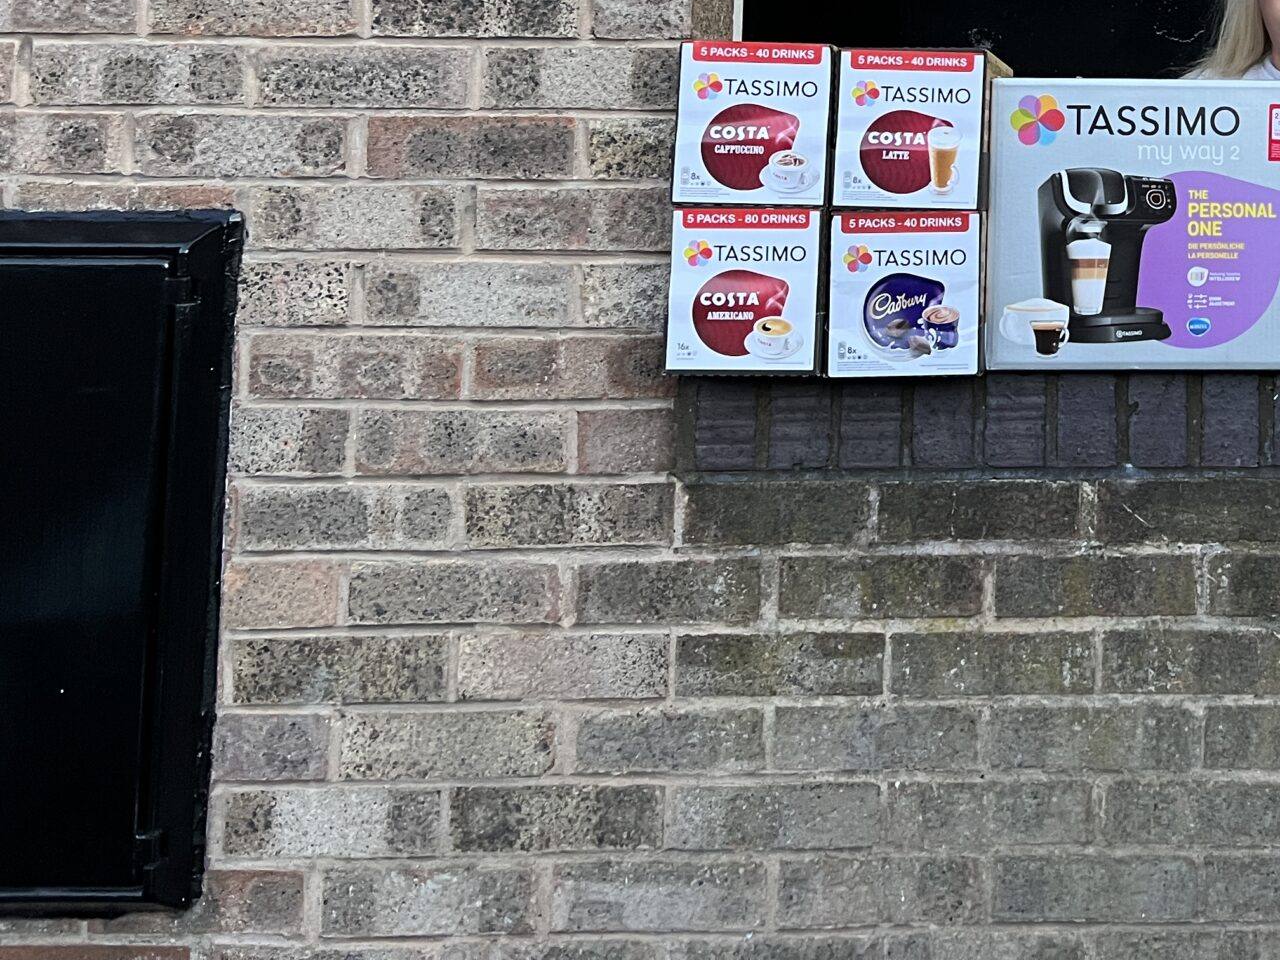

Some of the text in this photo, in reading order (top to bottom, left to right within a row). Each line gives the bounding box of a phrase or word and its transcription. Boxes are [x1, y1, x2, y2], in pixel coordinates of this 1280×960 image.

[700, 47, 708, 56] 5
[710, 47, 748, 57] PACKS
[756, 48, 769, 58] 40
[772, 49, 815, 59] DRINKS
[858, 55, 865, 64] 5
[867, 55, 903, 66] PACKS
[911, 56, 924, 66] 40
[926, 57, 967, 68] DRINKS
[724, 78, 818, 98] TASSIMO
[881, 85, 971, 104] TASSIMO
[1066, 104, 1240, 137] TASSIMO
[709, 125, 770, 141] COSTA
[867, 131, 926, 146] COSTA
[714, 144, 765, 155] CAPPUCCINO
[882, 150, 910, 160] LATTE
[1137, 143, 1240, 165] my way 2
[1188, 189, 1209, 200] THE
[1188, 202, 1277, 218] PERSONAL
[687, 214, 694, 223] 5
[696, 214, 736, 224] PACKS
[744, 214, 759, 224] 80
[761, 214, 806, 224] DRINKS
[849, 219, 856, 228] 5
[858, 218, 896, 228] PACKS
[904, 218, 917, 228] 40
[920, 217, 962, 228] DRINKS
[1187, 221, 1223, 237] ONE
[714, 245, 807, 262] TASSIMO
[873, 249, 967, 267] TASSIMO
[700, 292, 760, 307] COSTA
[870, 292, 928, 320] Cadbury
[707, 311, 754, 320] AMERICANO
